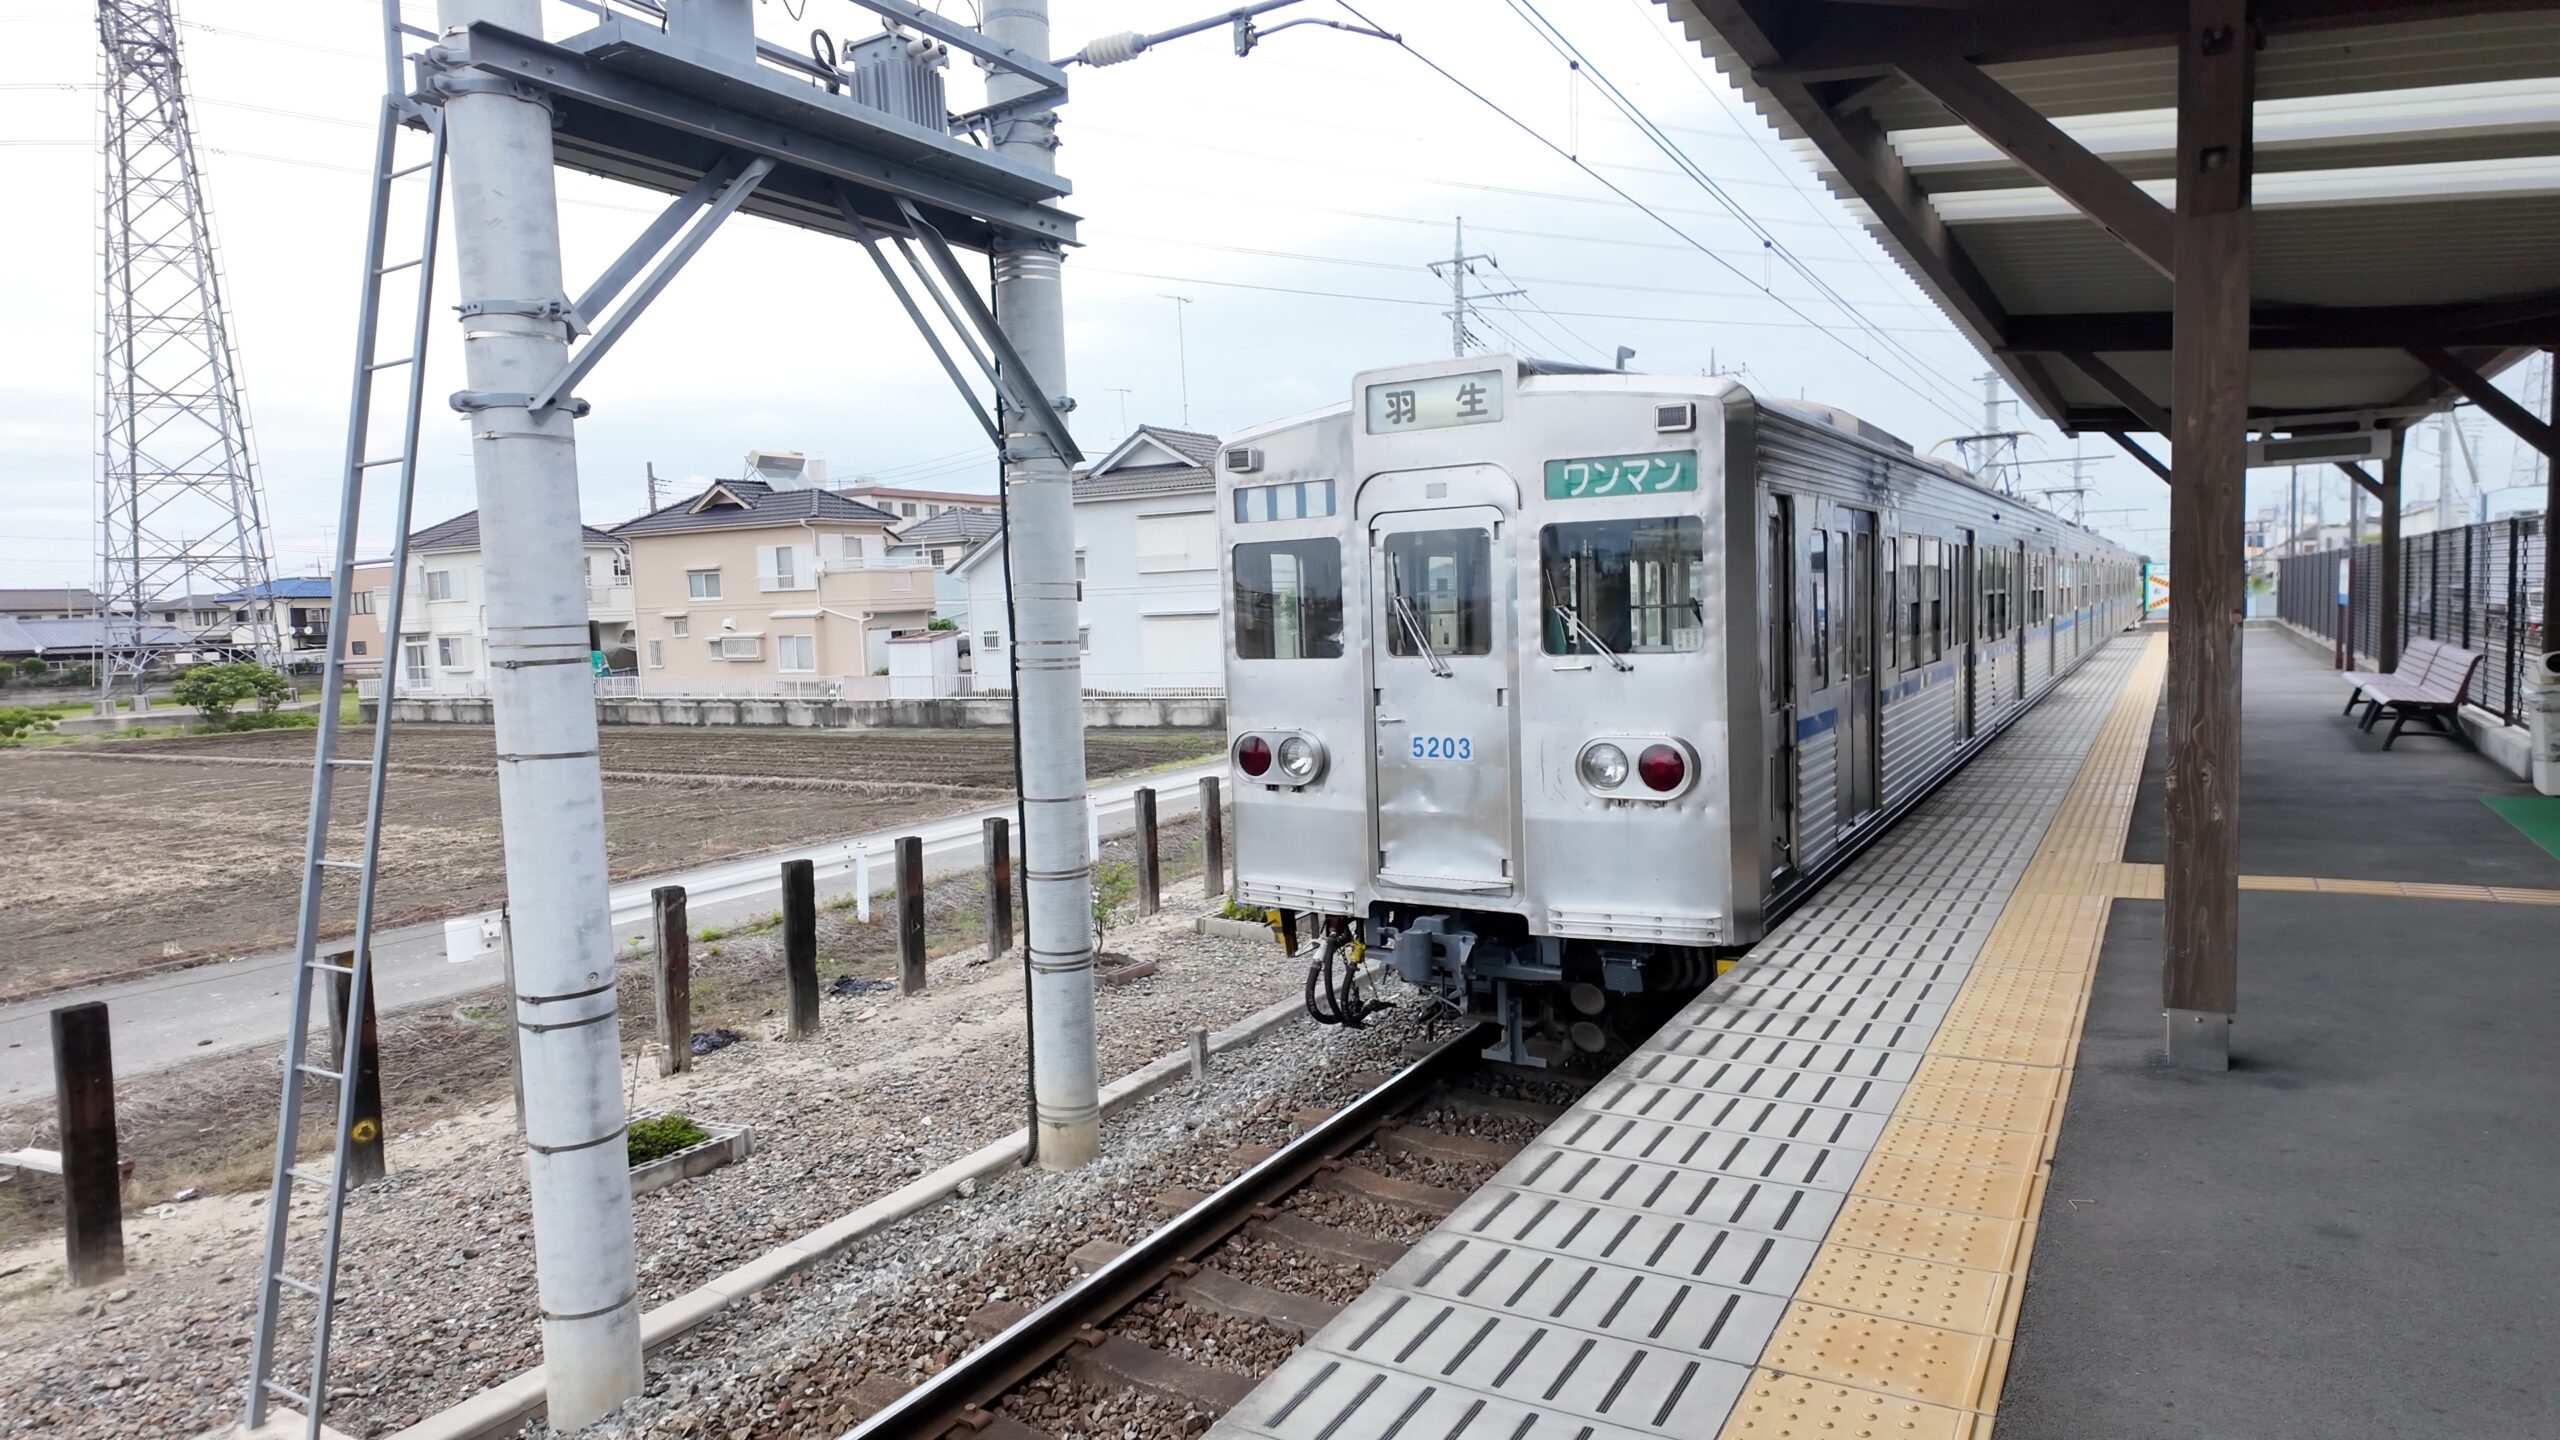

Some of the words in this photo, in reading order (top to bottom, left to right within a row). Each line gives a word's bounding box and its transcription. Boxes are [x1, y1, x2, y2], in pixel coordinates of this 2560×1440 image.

[1385, 382, 1488, 425] 羽生
[1563, 458, 1681, 496] ワンマン
[1412, 736, 1471, 759] 5203
